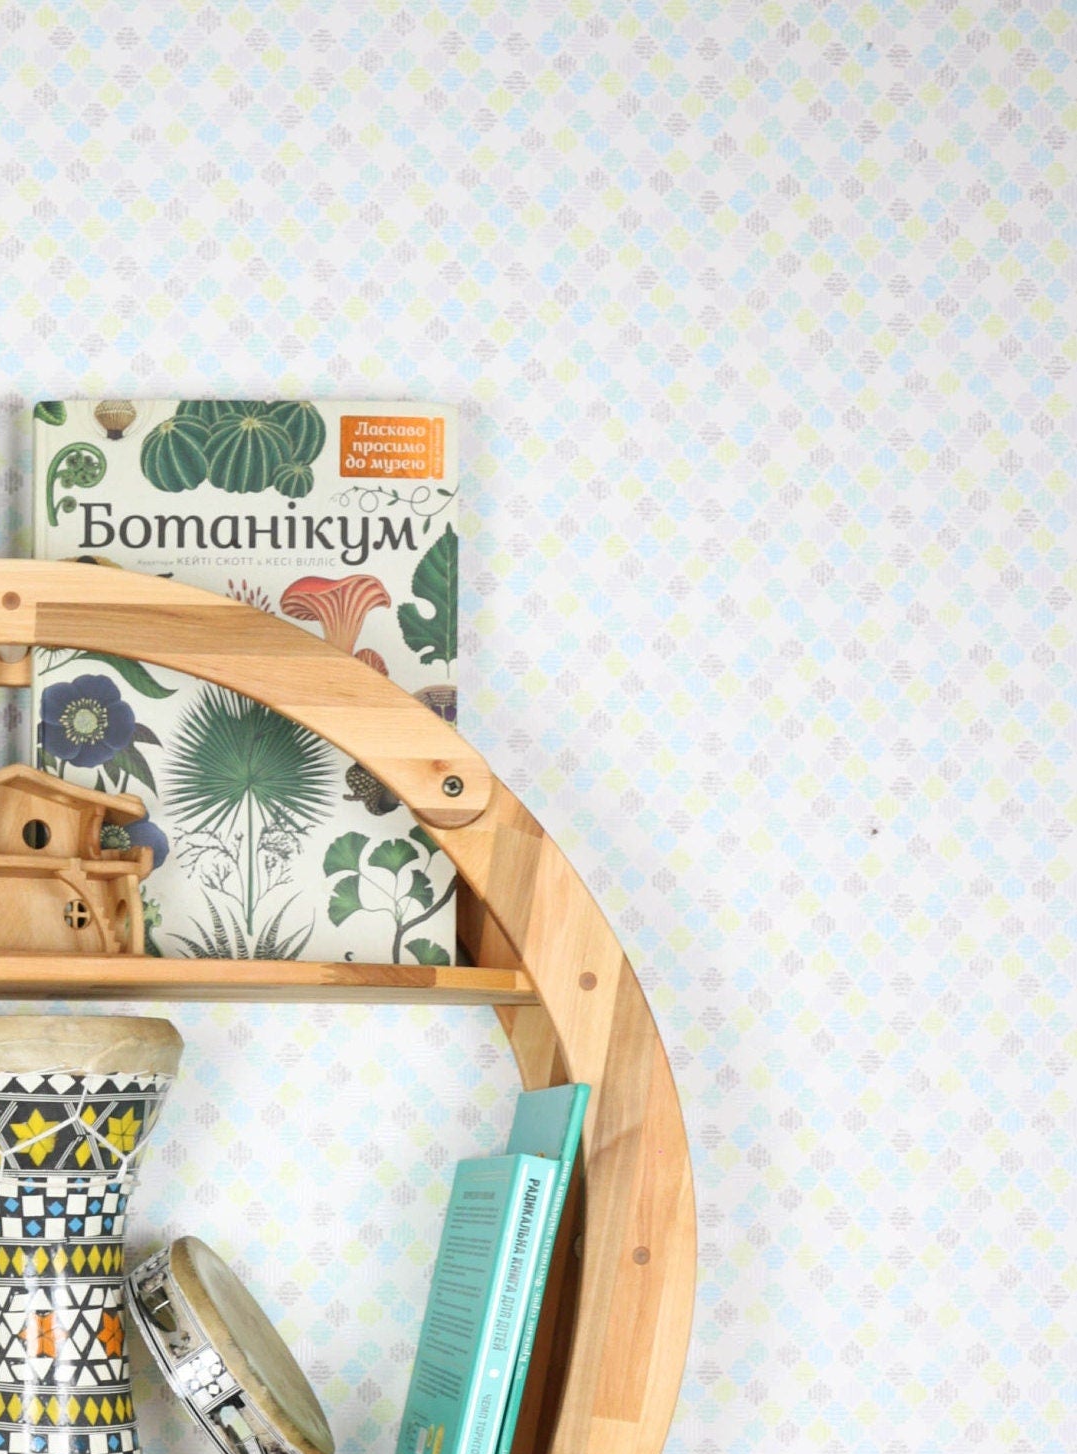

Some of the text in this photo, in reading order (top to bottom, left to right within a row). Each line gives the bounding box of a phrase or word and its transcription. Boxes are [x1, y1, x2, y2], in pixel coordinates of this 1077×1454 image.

[354, 421, 426, 437] Ласкаво
[352, 441, 426, 457] просимо
[345, 453, 426, 474] до музею
[78, 501, 419, 567] Ботанікум
[176, 556, 212, 566] КЕЙТІ
[215, 557, 254, 566] СКОТТ
[265, 557, 292, 567] КЕСІ
[296, 557, 337, 567] ВІЛЛІС
[492, 1177, 539, 1353] РАДИКАЛЬНА КНИГА ДЛЯ ДІТЕЙ
[477, 1392, 492, 1420] ЧЕМП
